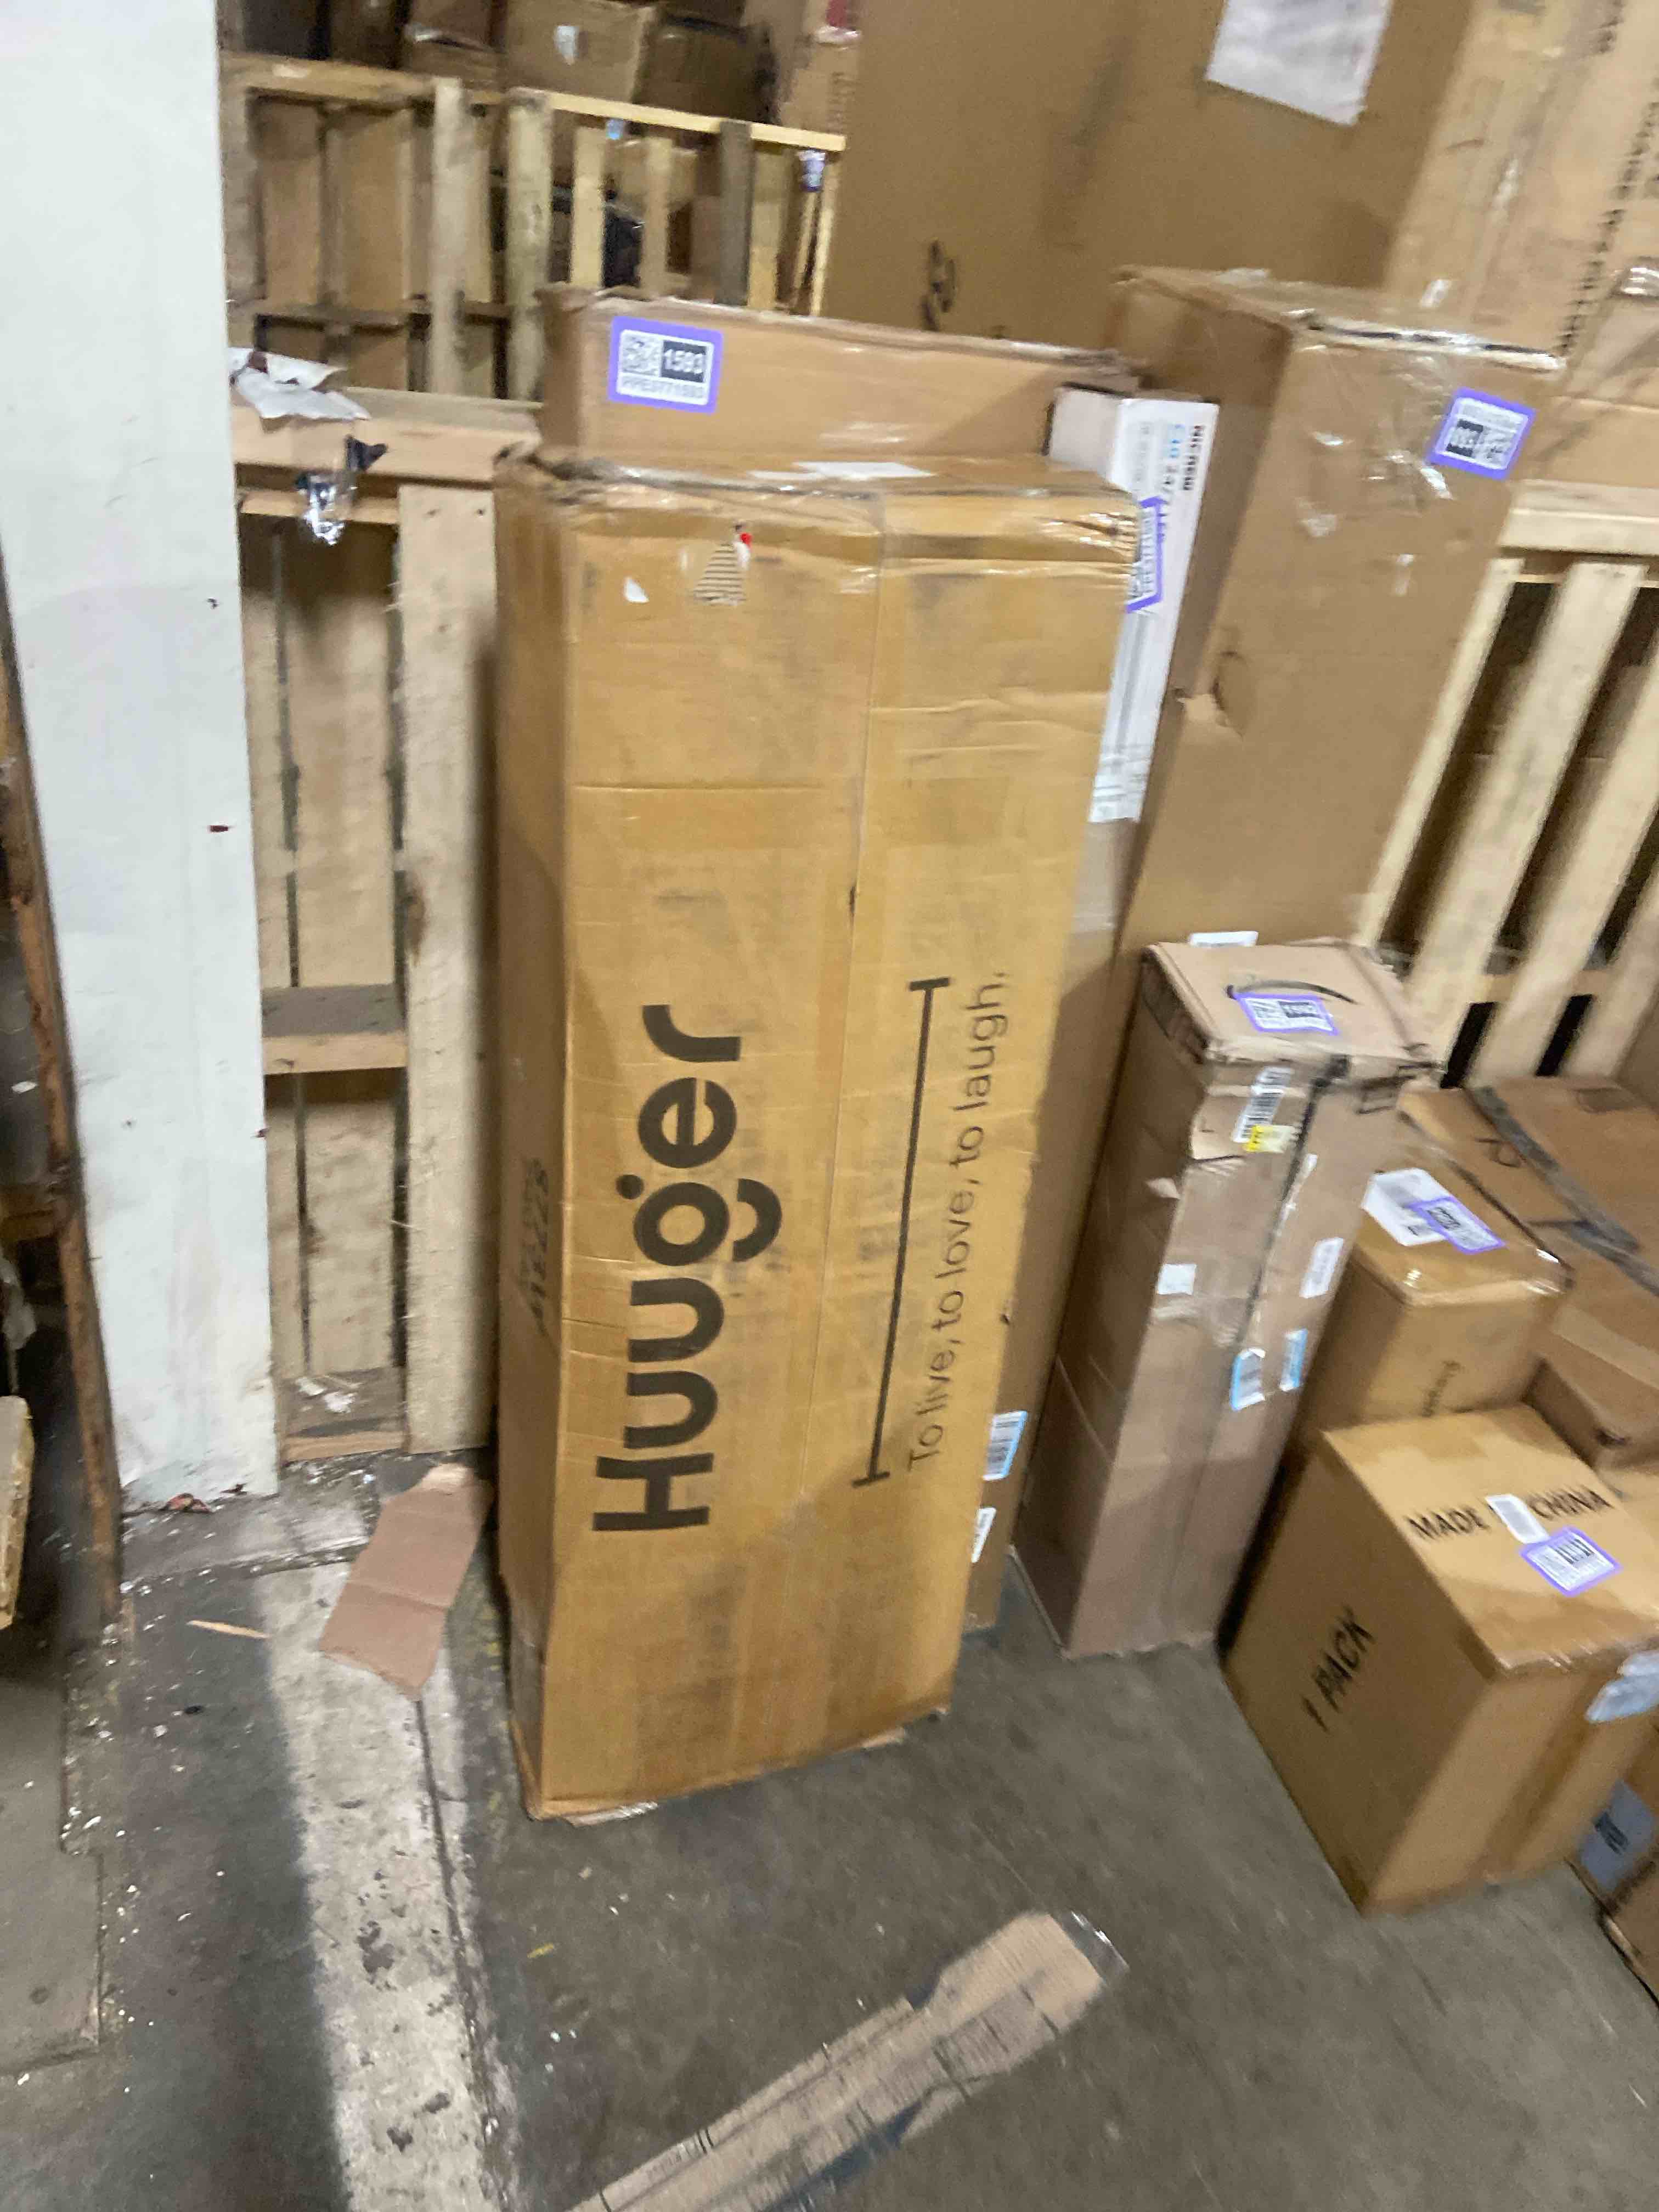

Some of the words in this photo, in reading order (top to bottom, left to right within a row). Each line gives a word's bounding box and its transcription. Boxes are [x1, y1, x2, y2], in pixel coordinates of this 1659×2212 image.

[949, 1126, 984, 1170] to
[934, 1178, 982, 1279] love,
[592, 1005, 782, 1531] Huuger
[931, 1289, 964, 1331] to
[914, 1339, 963, 1416] live,
[907, 1424, 944, 1472] To
[1405, 1505, 1490, 1540] MADE
[1527, 1485, 1614, 1520] CHINA
[1312, 1605, 1376, 1713] PACK
